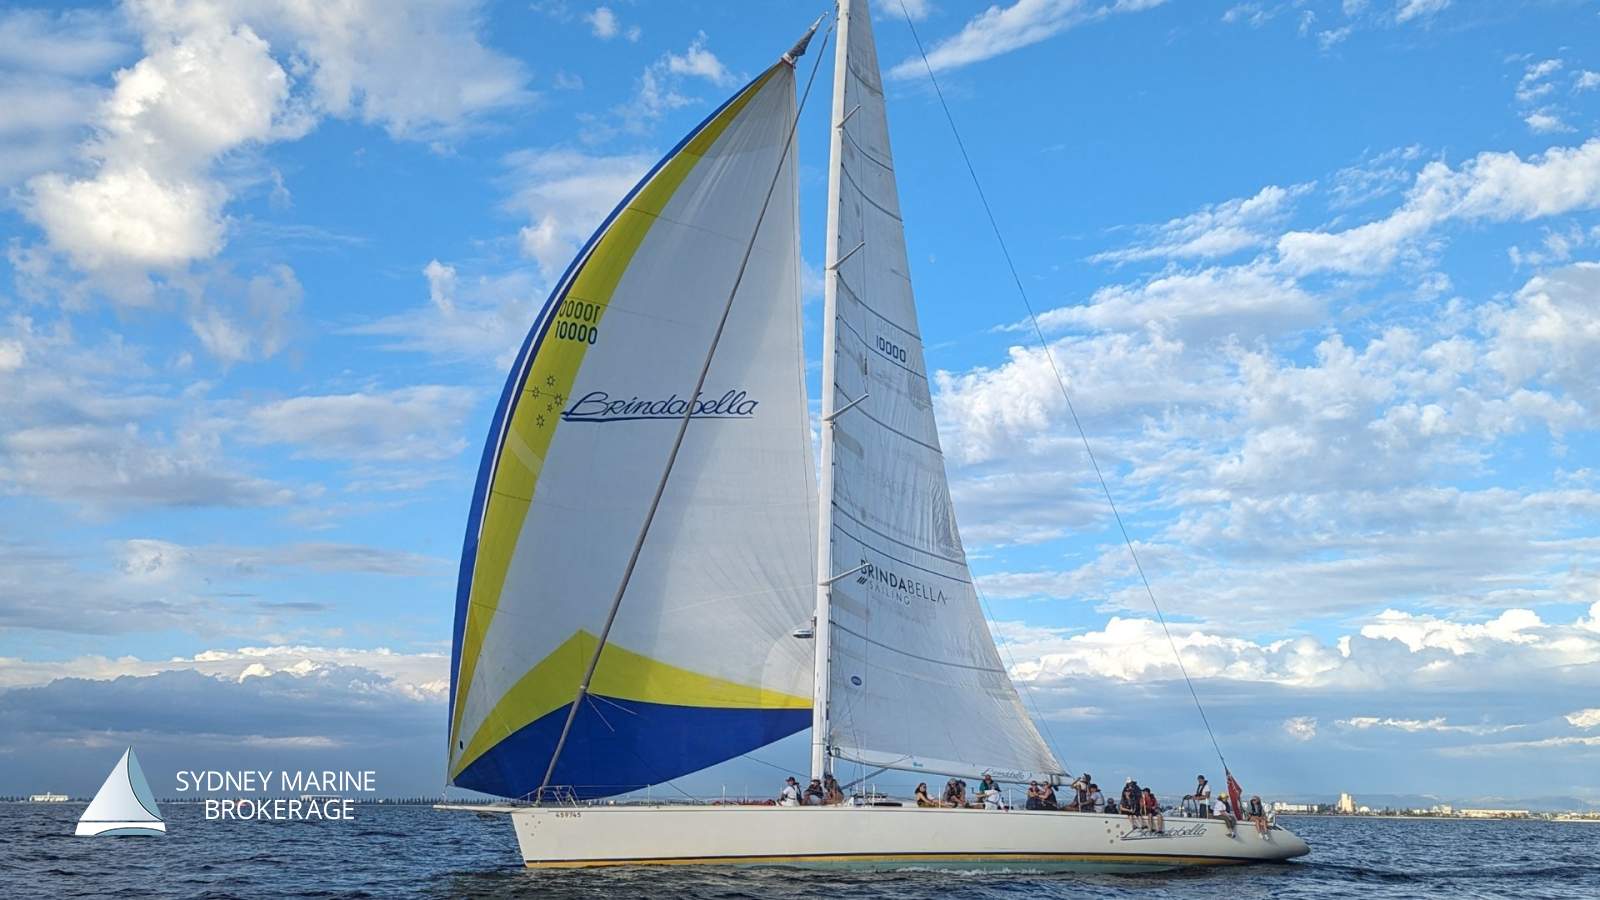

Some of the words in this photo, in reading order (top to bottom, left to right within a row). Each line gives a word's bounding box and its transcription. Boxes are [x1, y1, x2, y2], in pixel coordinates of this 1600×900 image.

[555, 320, 598, 345] 10000
[876, 335, 906, 363] 10000
[860, 559, 946, 604] BRINDABELLA
[869, 581, 910, 605] SAILING
